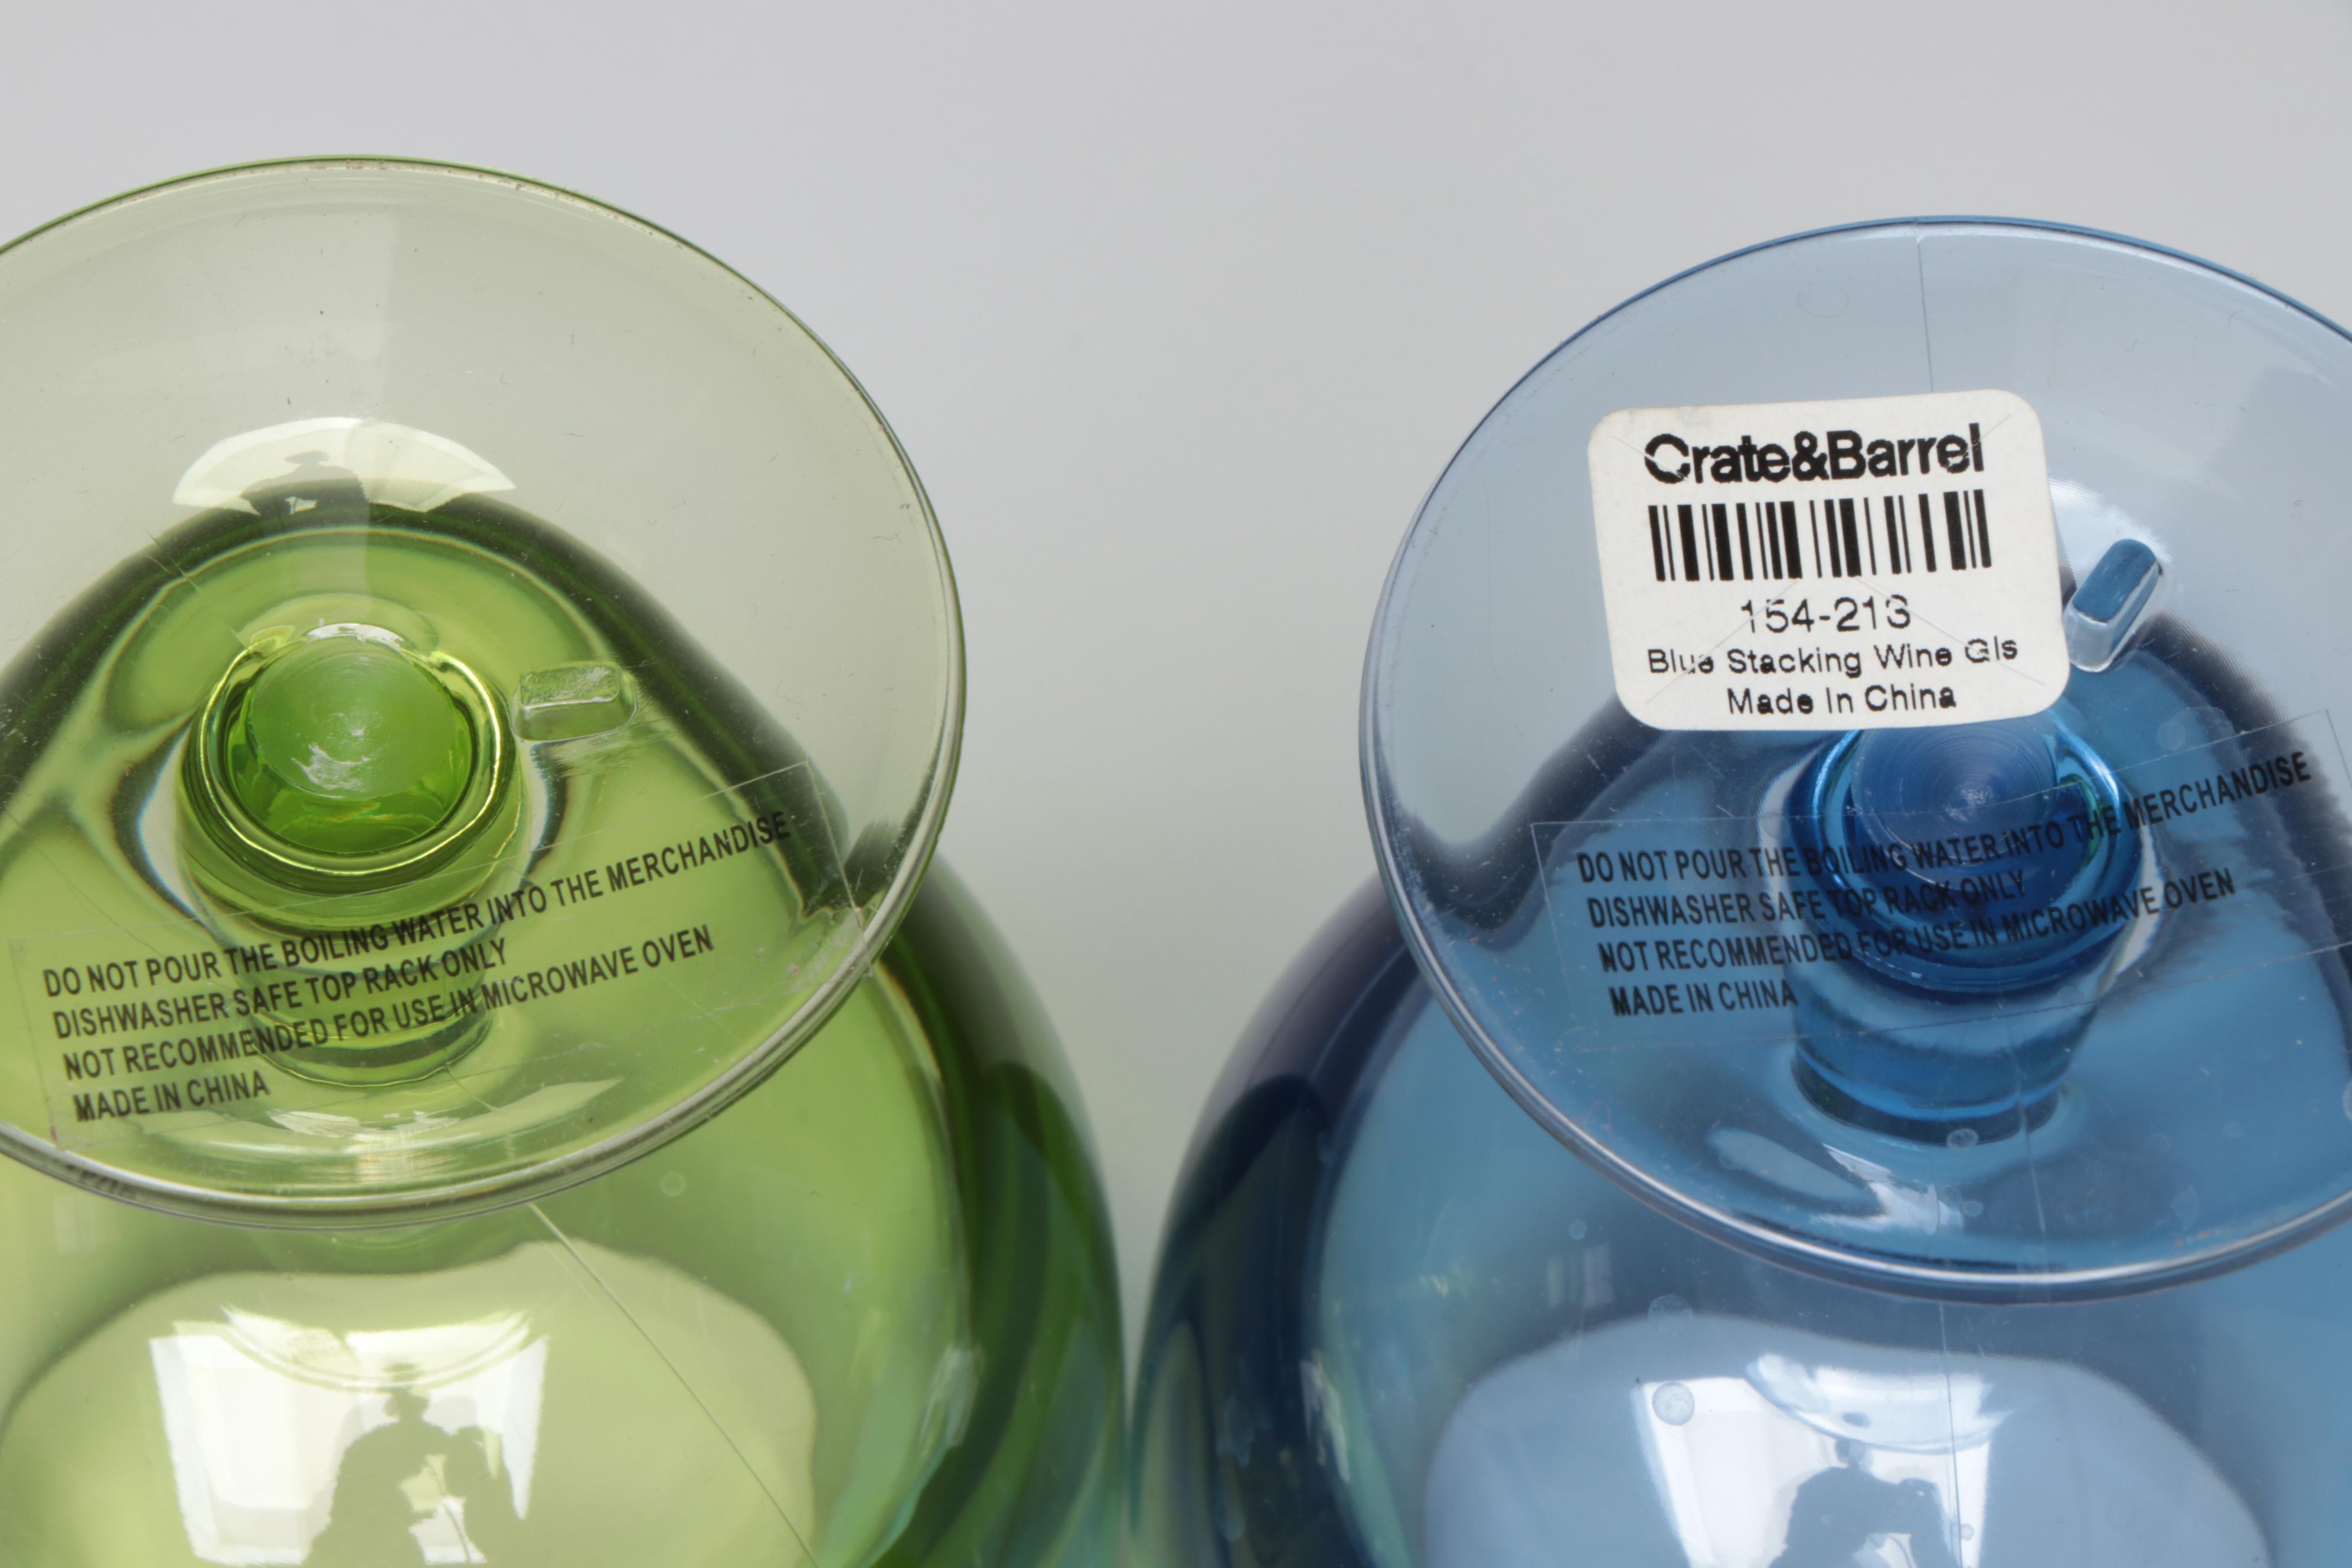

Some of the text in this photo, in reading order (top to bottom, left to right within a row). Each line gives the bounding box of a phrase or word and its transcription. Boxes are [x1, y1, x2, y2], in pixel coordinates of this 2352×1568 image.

[1644, 423, 1984, 484] Crate&Barrel
[1741, 594, 1911, 633] 154-213
[1648, 636, 2018, 678] Blue Stacking Wine Gls
[1726, 683, 1956, 715] Made In China
[1577, 752, 2311, 883] DO NOT POUR THE BOILING WATER INTO THE MERCHANDISE
[44, 812, 790, 997] DO NOT POUR THE BOILING WATER INTO THE MERCHANDISE
[1586, 870, 2026, 928] DISHWASHER SAFE TOP RACK ONLY
[1598, 867, 2235, 972] NOT RECOMMENDED FOR USE IN MICROWAVE OVEN
[53, 939, 507, 1039] DISHWASHER SAFE TOP RACK ONLY
[63, 924, 714, 1080] NOT RECOMMENDED FOR USE IN MICROWAVE OVEN
[1608, 979, 1798, 1017] MADE IN CHINA
[73, 1070, 271, 1121] MADE IN CHINA
